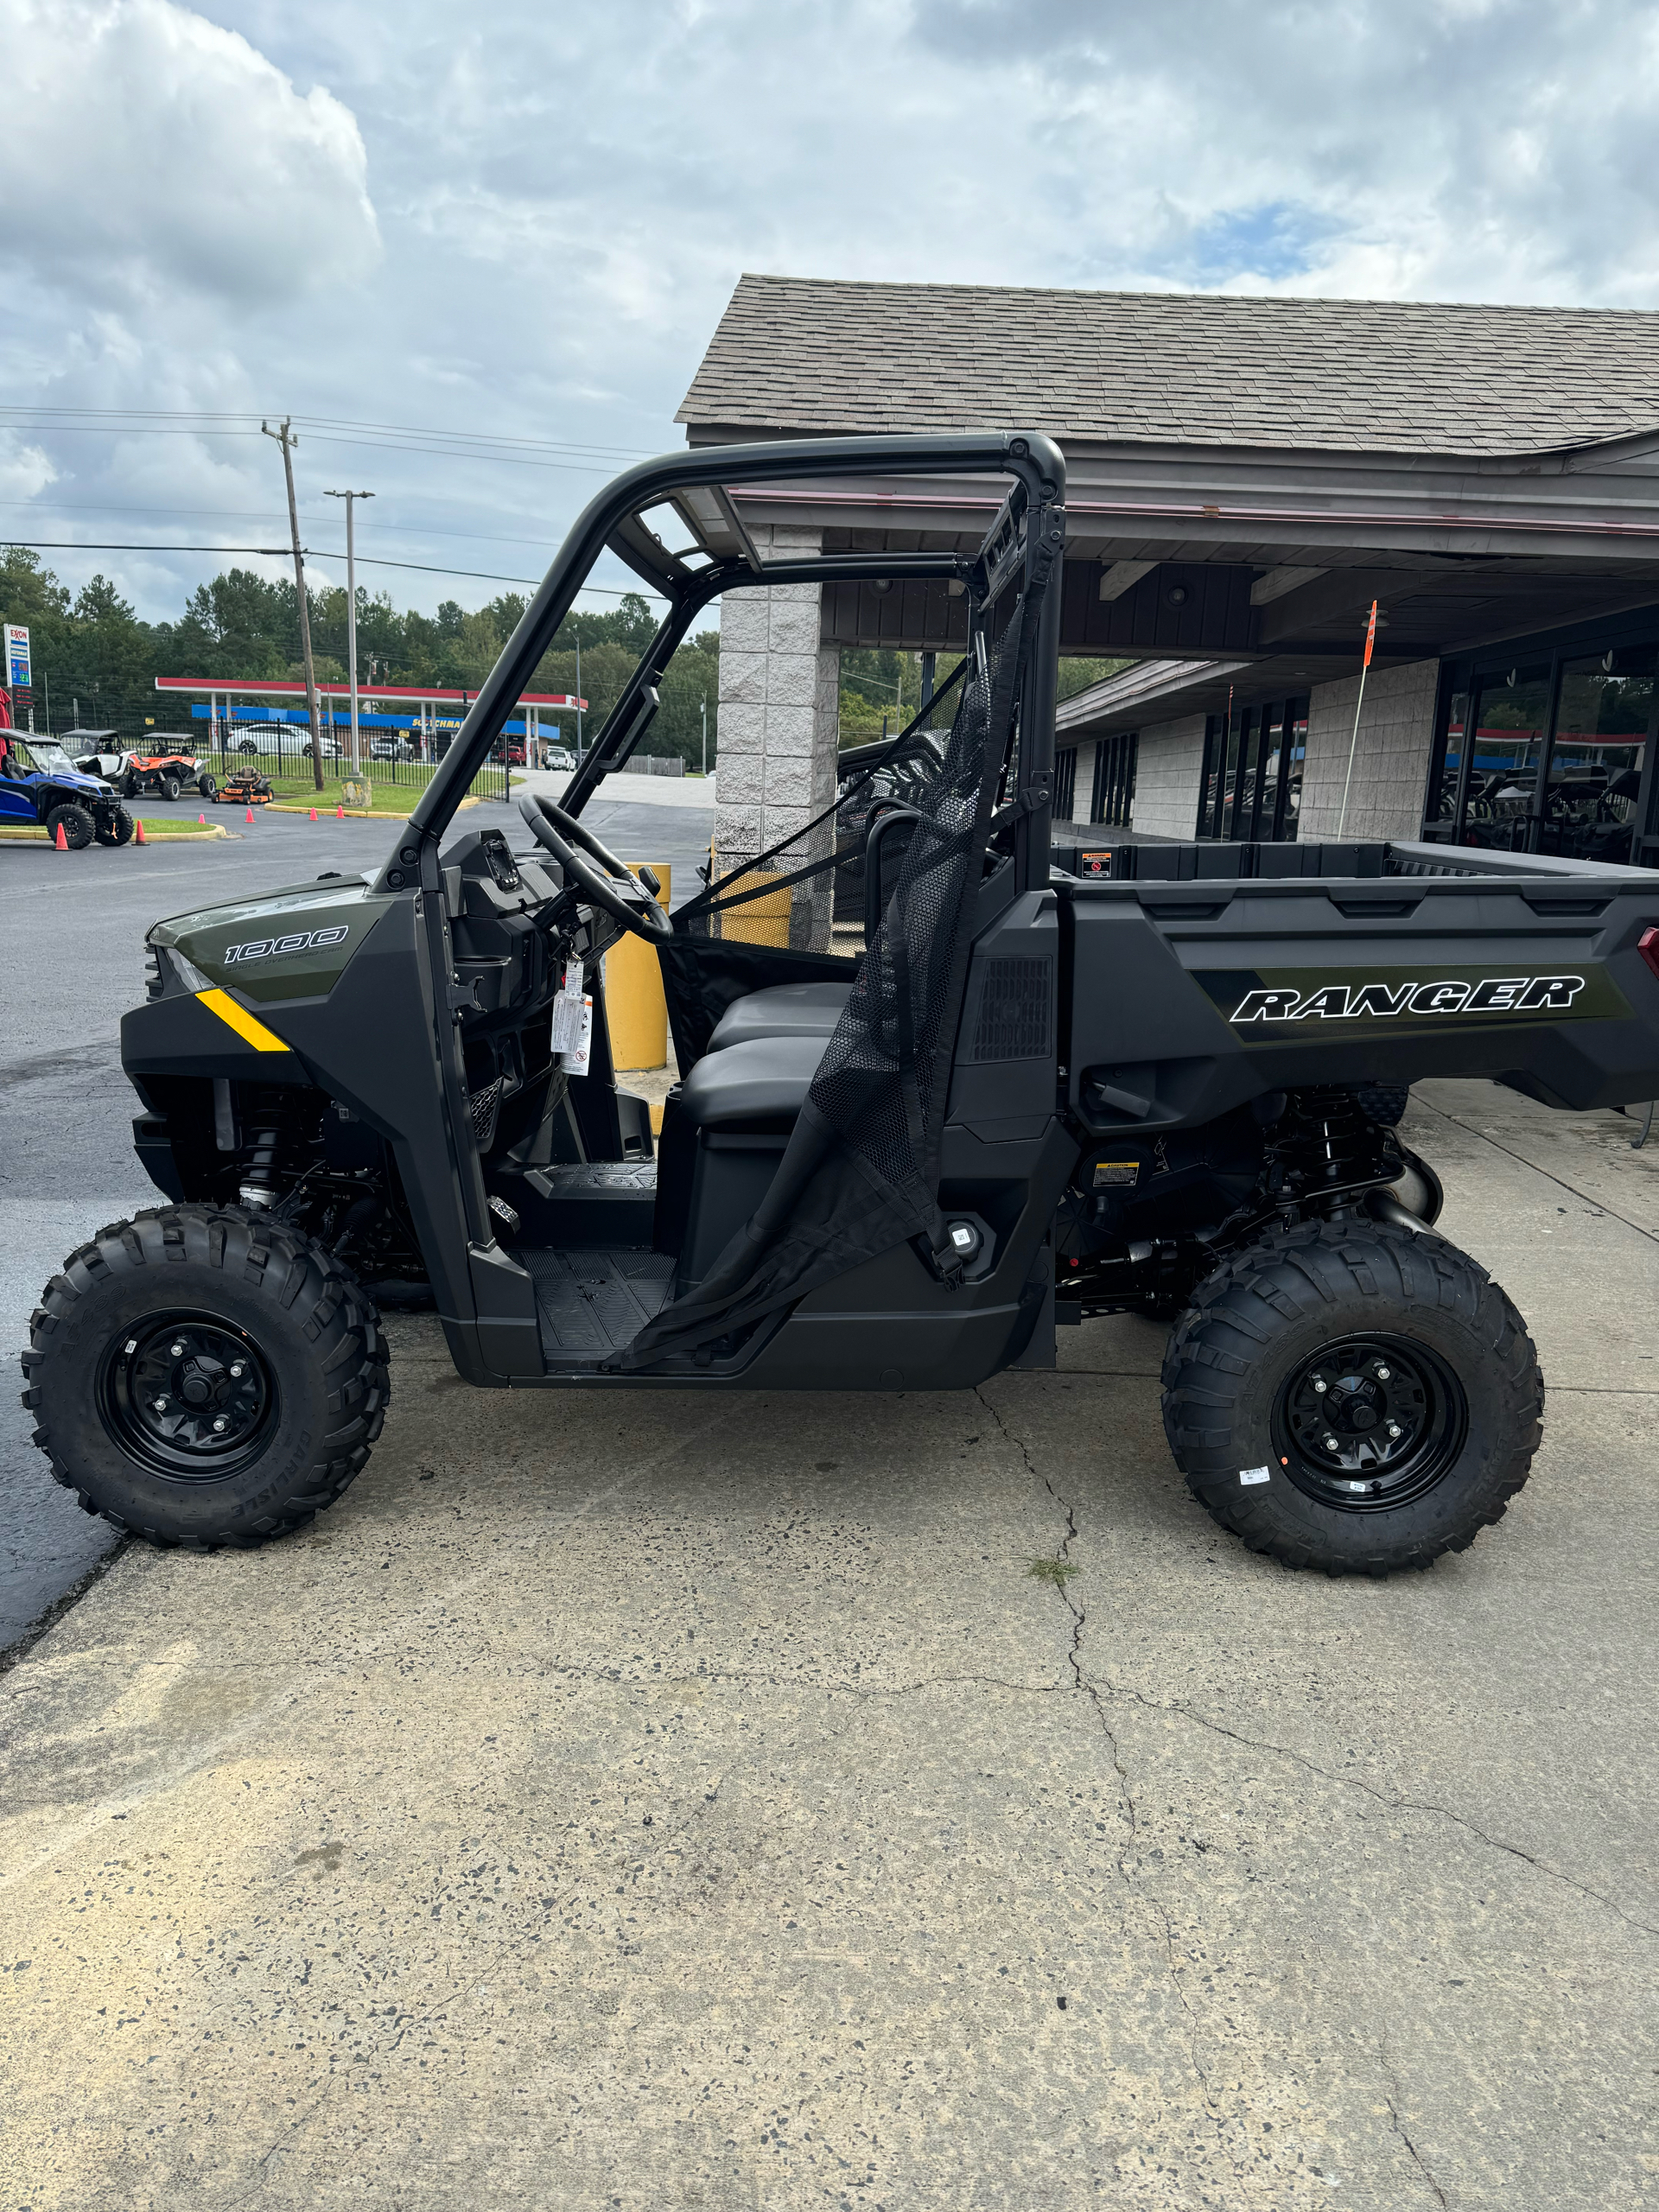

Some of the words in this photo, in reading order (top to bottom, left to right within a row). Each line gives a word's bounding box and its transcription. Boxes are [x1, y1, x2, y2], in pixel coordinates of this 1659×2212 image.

[10, 629, 27, 640] EXXON
[412, 718, 465, 728] SCOTCHMA
[224, 925, 349, 964] 1000
[226, 962, 261, 973] SINGLE
[264, 950, 319, 965] OVERHEAD
[320, 946, 344, 956] CAM
[1230, 976, 1586, 1023] RANGER
[230, 1428, 313, 1520] CARLISLE
